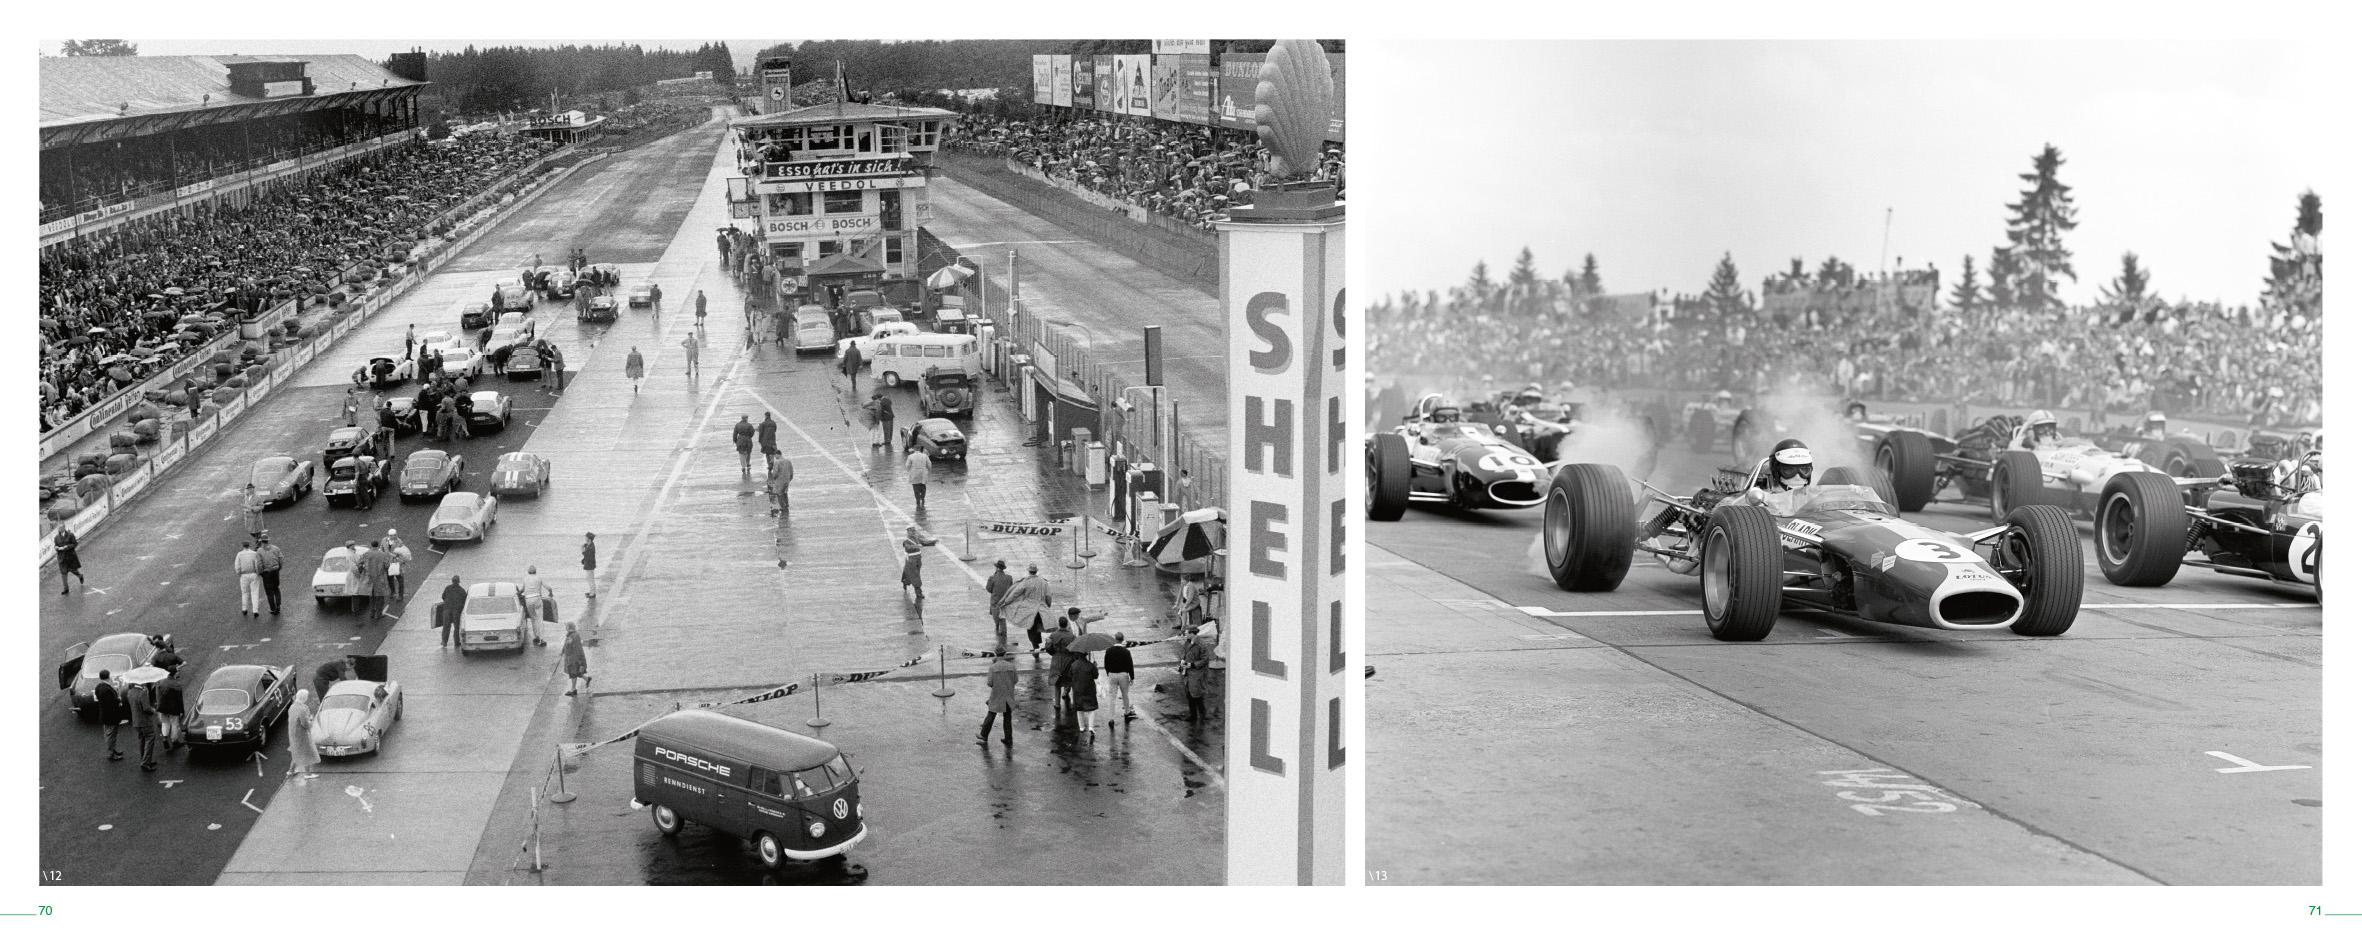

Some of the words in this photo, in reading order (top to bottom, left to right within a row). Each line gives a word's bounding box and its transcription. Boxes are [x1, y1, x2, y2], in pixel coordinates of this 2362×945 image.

[778, 165, 811, 177] ESSO
[847, 161, 861, 174] in
[805, 179, 877, 192] VEEDOL
[769, 221, 809, 233] BOSCH
[831, 217, 871, 230] BOSCH
[89, 397, 123, 431] Continental
[1488, 455, 1536, 468] 10
[991, 523, 1063, 537] DUNLOP
[1244, 290, 1294, 779] SHELL
[1916, 541, 1962, 560] 3
[224, 716, 244, 732] 53
[655, 746, 732, 777] PORSCHE
[663, 776, 706, 796] RENNDIENST
